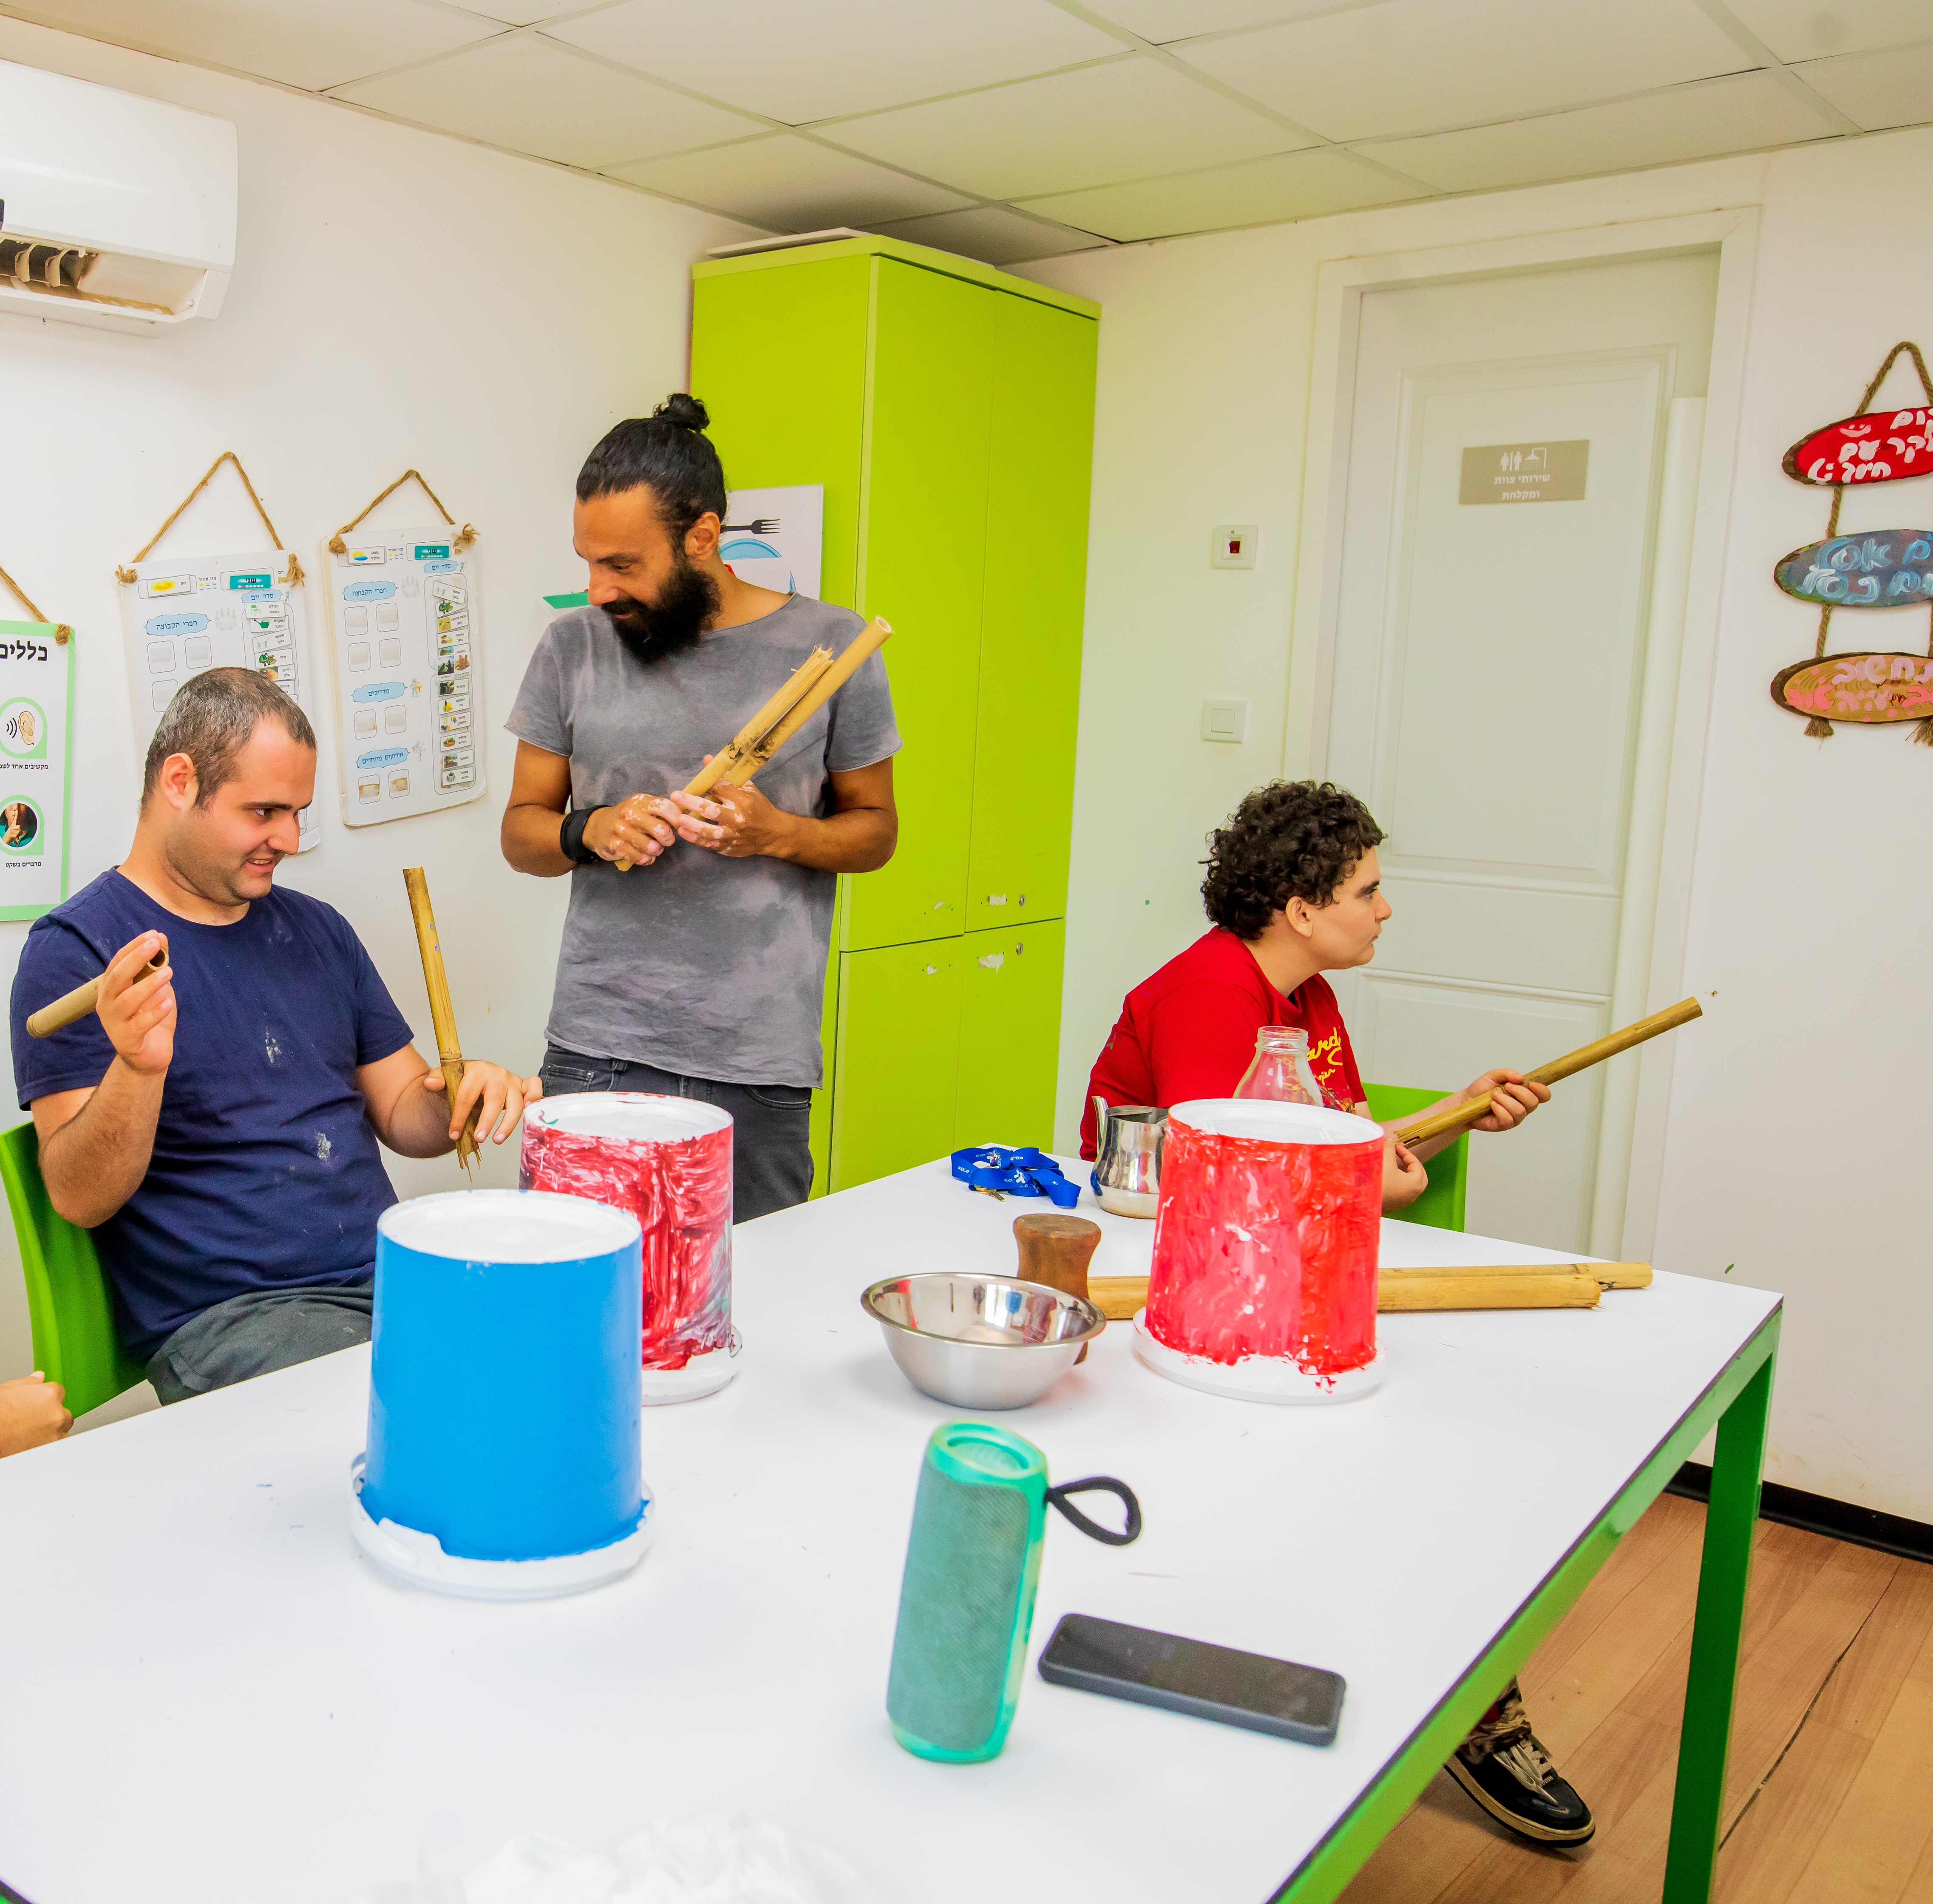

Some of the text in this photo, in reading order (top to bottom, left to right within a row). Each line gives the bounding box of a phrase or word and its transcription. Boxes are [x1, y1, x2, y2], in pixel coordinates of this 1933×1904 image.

[1494, 474, 1550, 484] שירותי צוות
[1502, 490, 1539, 500] ומקלחת
